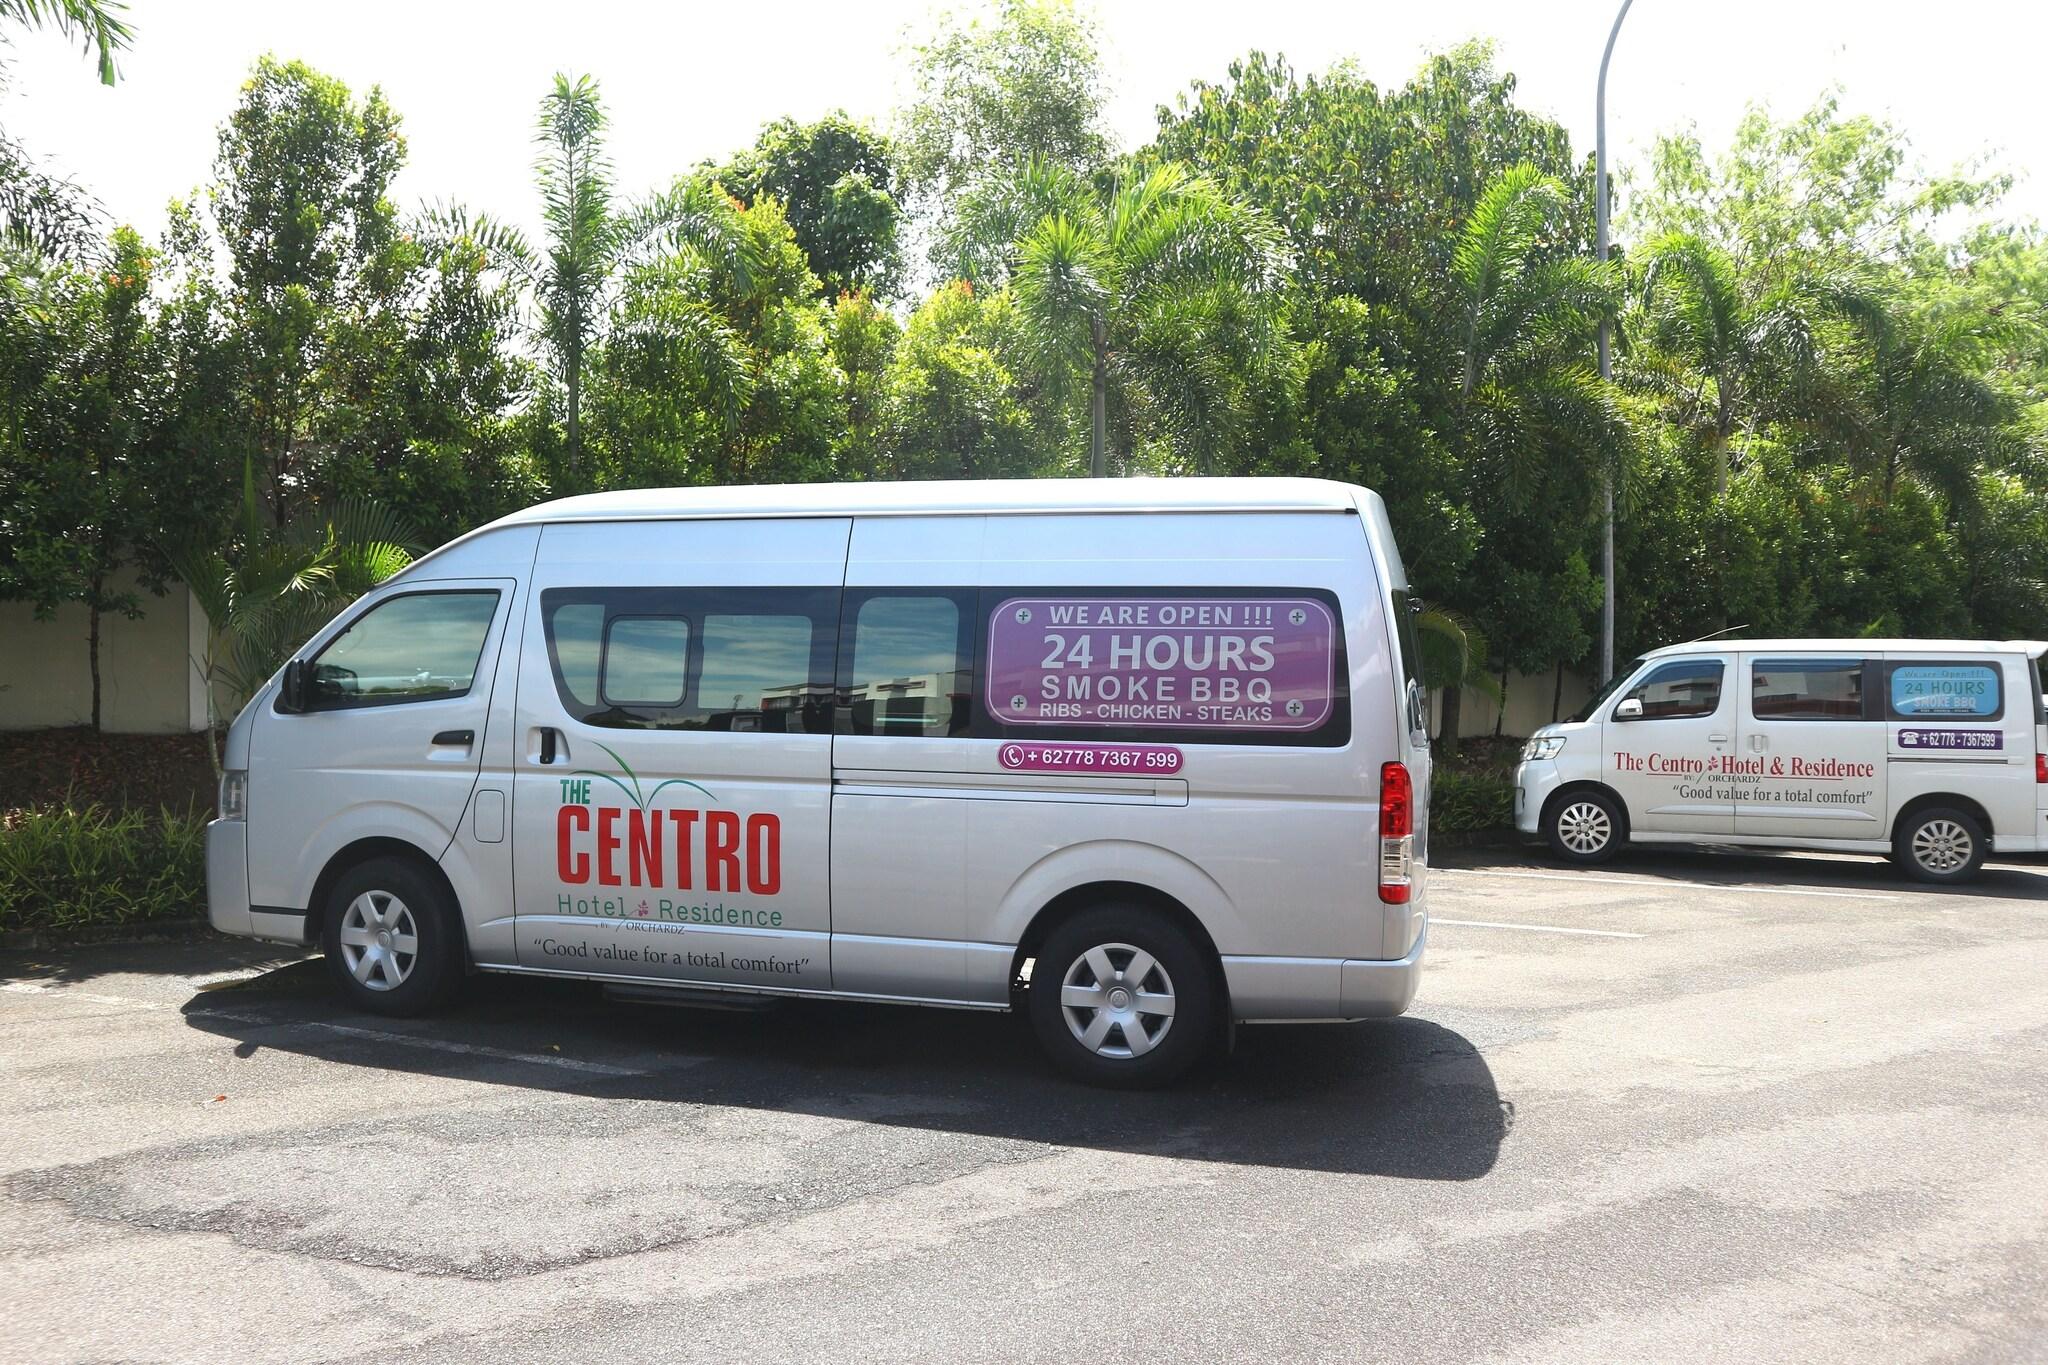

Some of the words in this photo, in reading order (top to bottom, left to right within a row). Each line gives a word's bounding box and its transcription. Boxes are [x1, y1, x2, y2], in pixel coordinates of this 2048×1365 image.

[1049, 606, 1089, 624] WE
[1097, 606, 1149, 625] ARE
[1158, 606, 1232, 625] OPEN
[1243, 606, 1272, 625] !!!
[1041, 634, 1093, 669] 24
[1110, 635, 1275, 672] HOURS
[1041, 675, 1176, 701] SMOKE
[1191, 677, 1272, 705] BBQ
[1905, 682, 1924, 695] 24
[1931, 681, 1985, 695] HOURS
[1914, 696, 1951, 708] SMOKE
[1953, 696, 1977, 709] BBQ
[1040, 703, 1082, 718] RIBS
[1097, 704, 1181, 719] CHICKEN
[1197, 705, 1272, 721] STEAKS
[1962, 733, 1996, 747] 7367599
[1042, 750, 1095, 766] 62778
[1100, 751, 1140, 767] 7367
[1146, 752, 1178, 768] 599
[1614, 752, 1643, 771] The
[1648, 753, 1703, 773] Centro
[1721, 755, 1764, 775] Hotel
[1770, 756, 1785, 775] &
[1791, 757, 1874, 777] Residence
[1708, 775, 1761, 783] ORCHARDZ
[560, 779, 591, 804] THE
[1716, 786, 1750, 800] value
[1753, 786, 1772, 801] for
[1774, 791, 1781, 801] a
[1785, 788, 1812, 802] total
[557, 805, 781, 895] CENTRO
[557, 893, 626, 917] Hotel
[659, 899, 783, 926] Residence
[626, 922, 685, 935] ORCHARDZ
[593, 944, 638, 962] value
[643, 946, 667, 964] for
[672, 953, 682, 965] a
[687, 951, 725, 969] total
